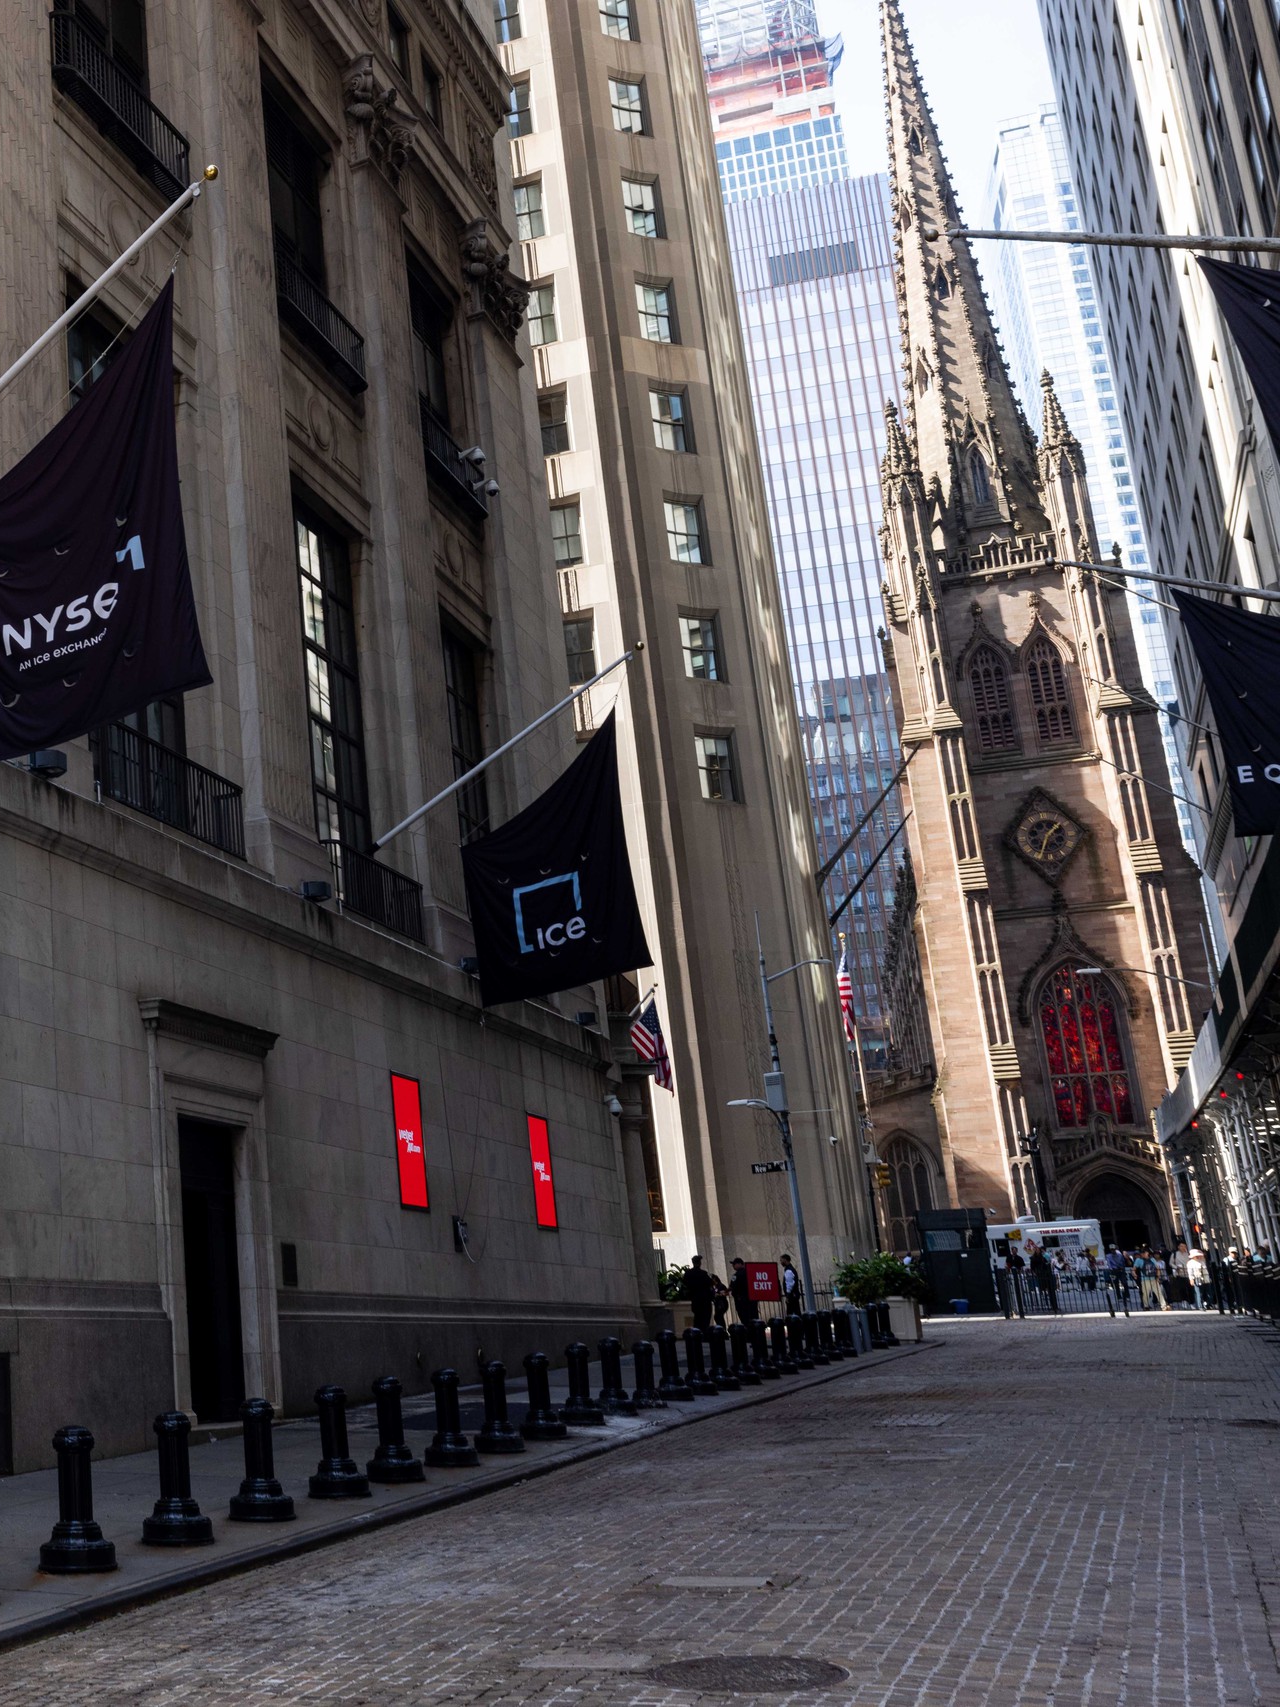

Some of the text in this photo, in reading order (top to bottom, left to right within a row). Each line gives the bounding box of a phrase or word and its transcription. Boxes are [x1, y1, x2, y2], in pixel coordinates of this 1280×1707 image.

[19, 659, 32, 672] AN
[756, 1271, 768, 1281] NO
[753, 1281, 773, 1290] EXIT
